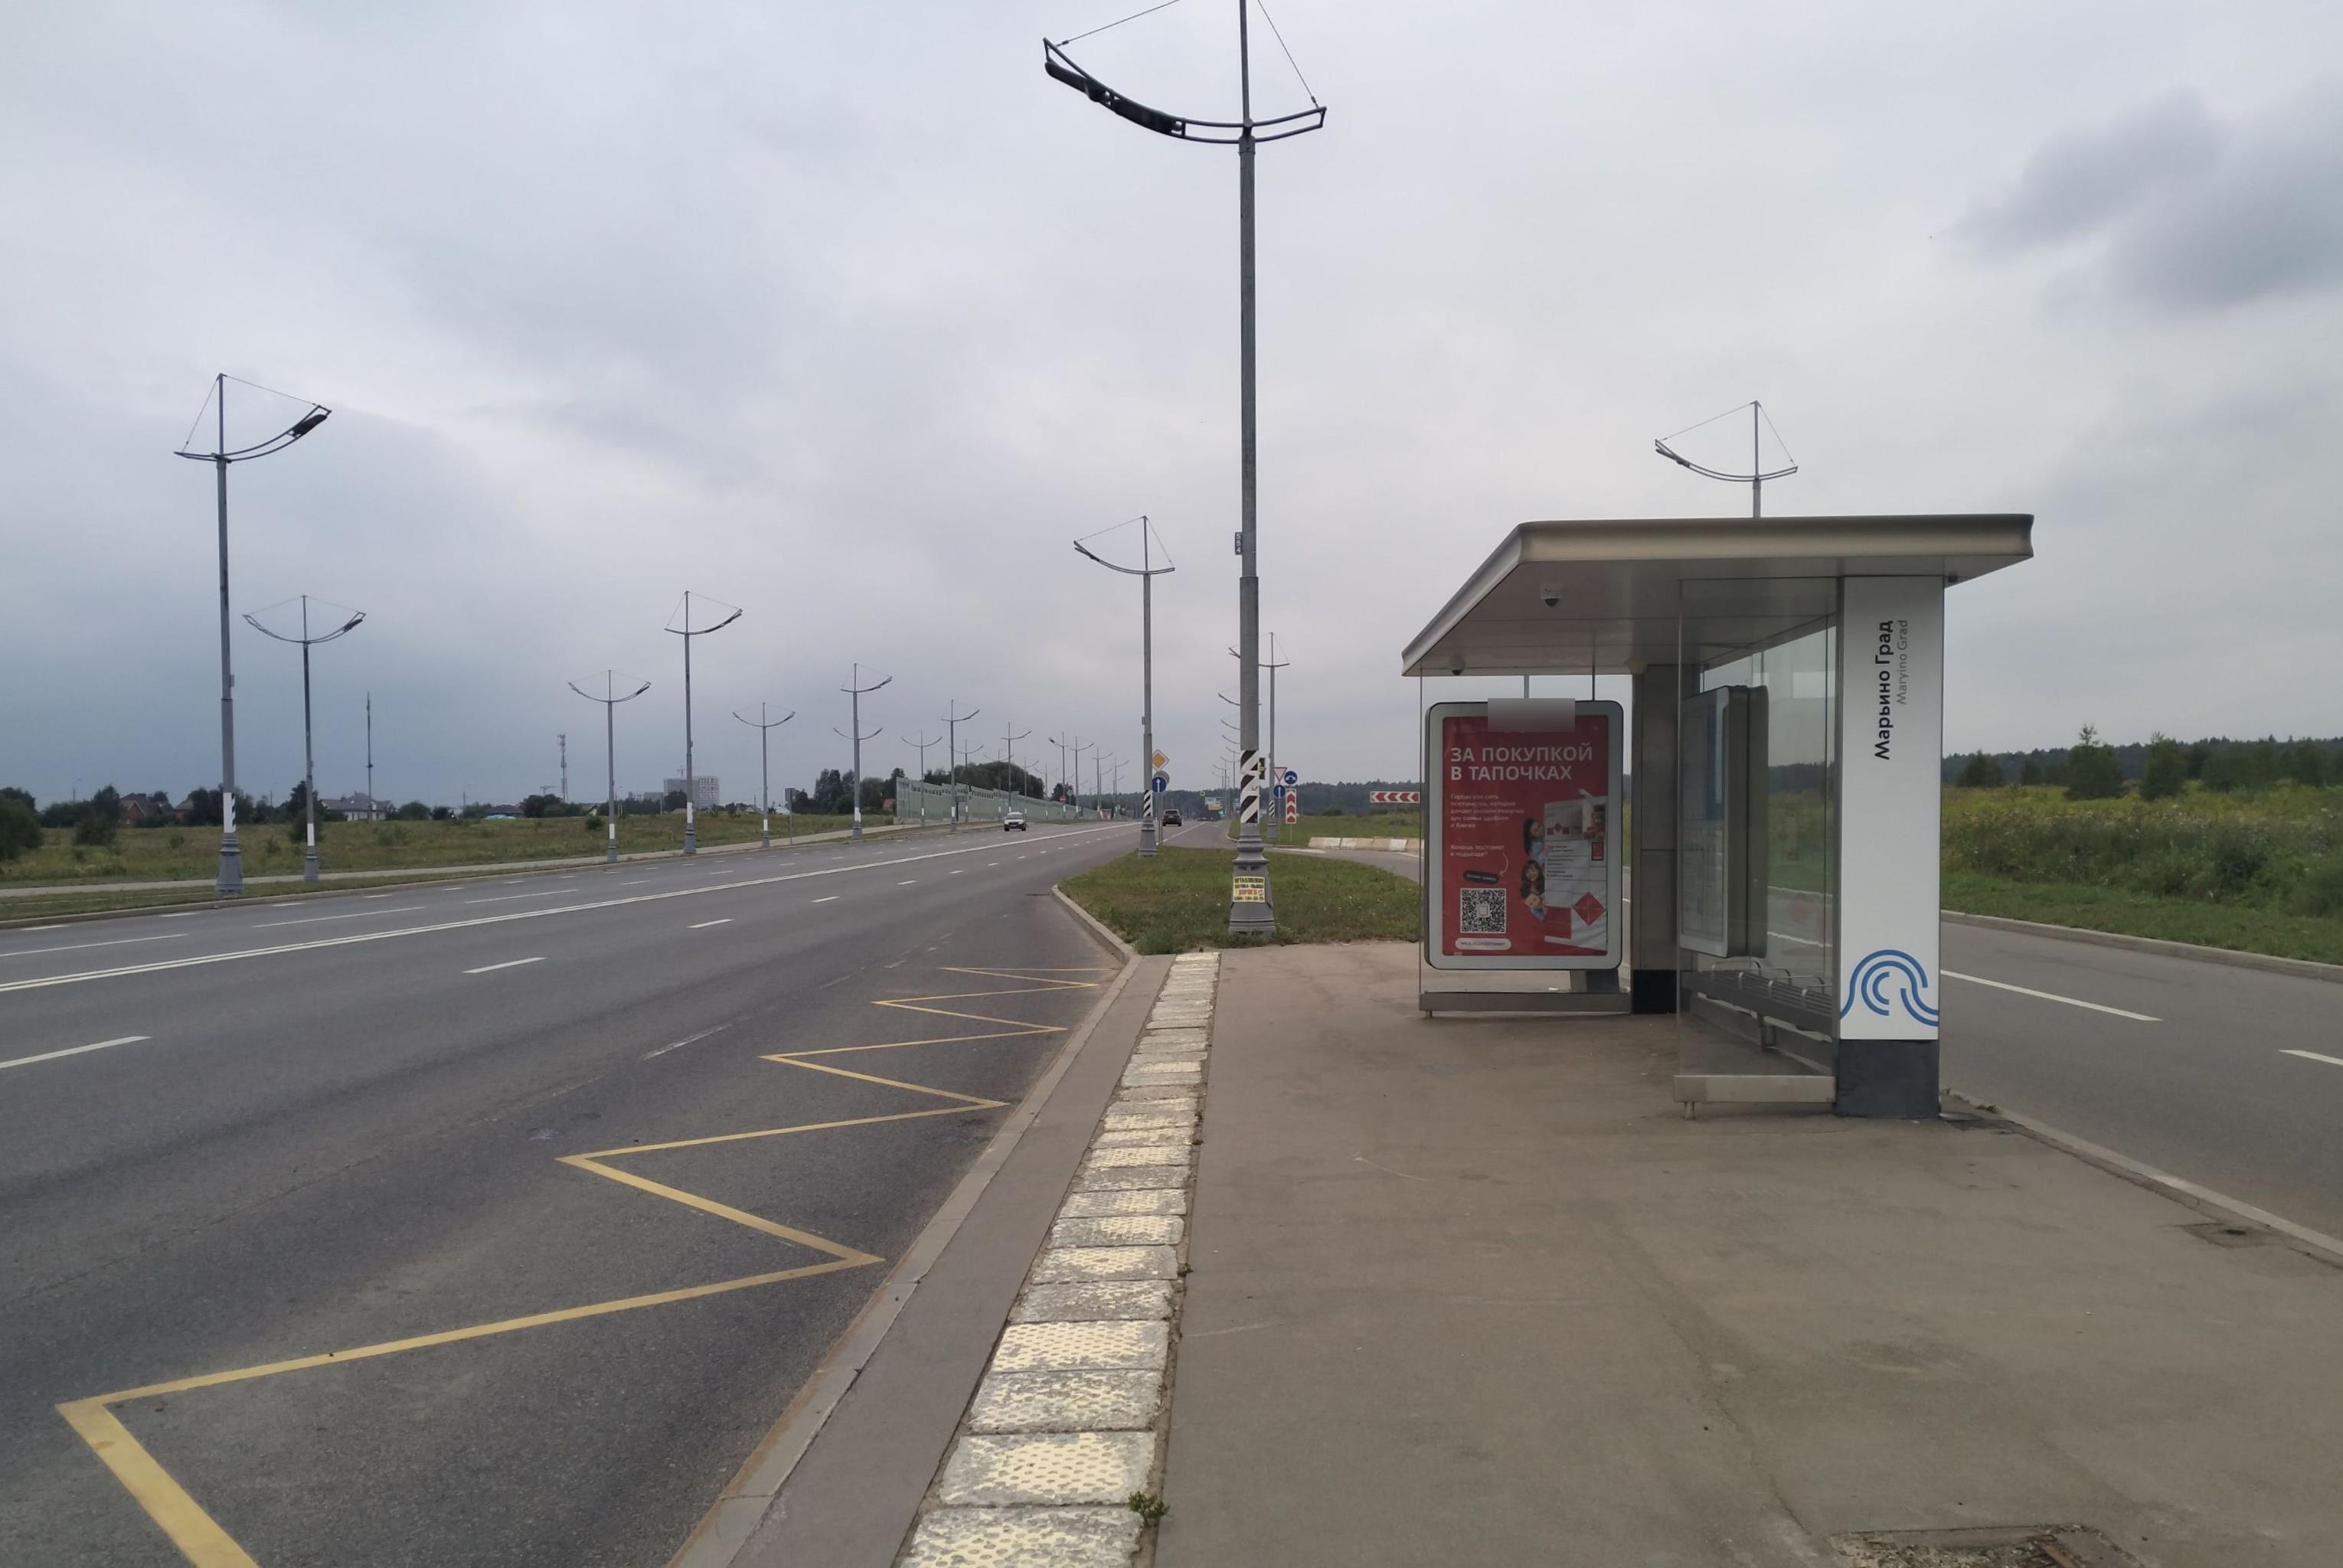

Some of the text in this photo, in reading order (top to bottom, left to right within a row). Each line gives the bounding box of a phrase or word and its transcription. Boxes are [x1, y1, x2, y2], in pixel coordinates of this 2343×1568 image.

[1896, 619, 1910, 705] Maryino Grad
[1874, 620, 1894, 760] Марьино Град
[1450, 742, 1593, 763] ЗА ПОКУПКОЙ
[1451, 766, 1572, 781] В ТАПОЧКАХ
